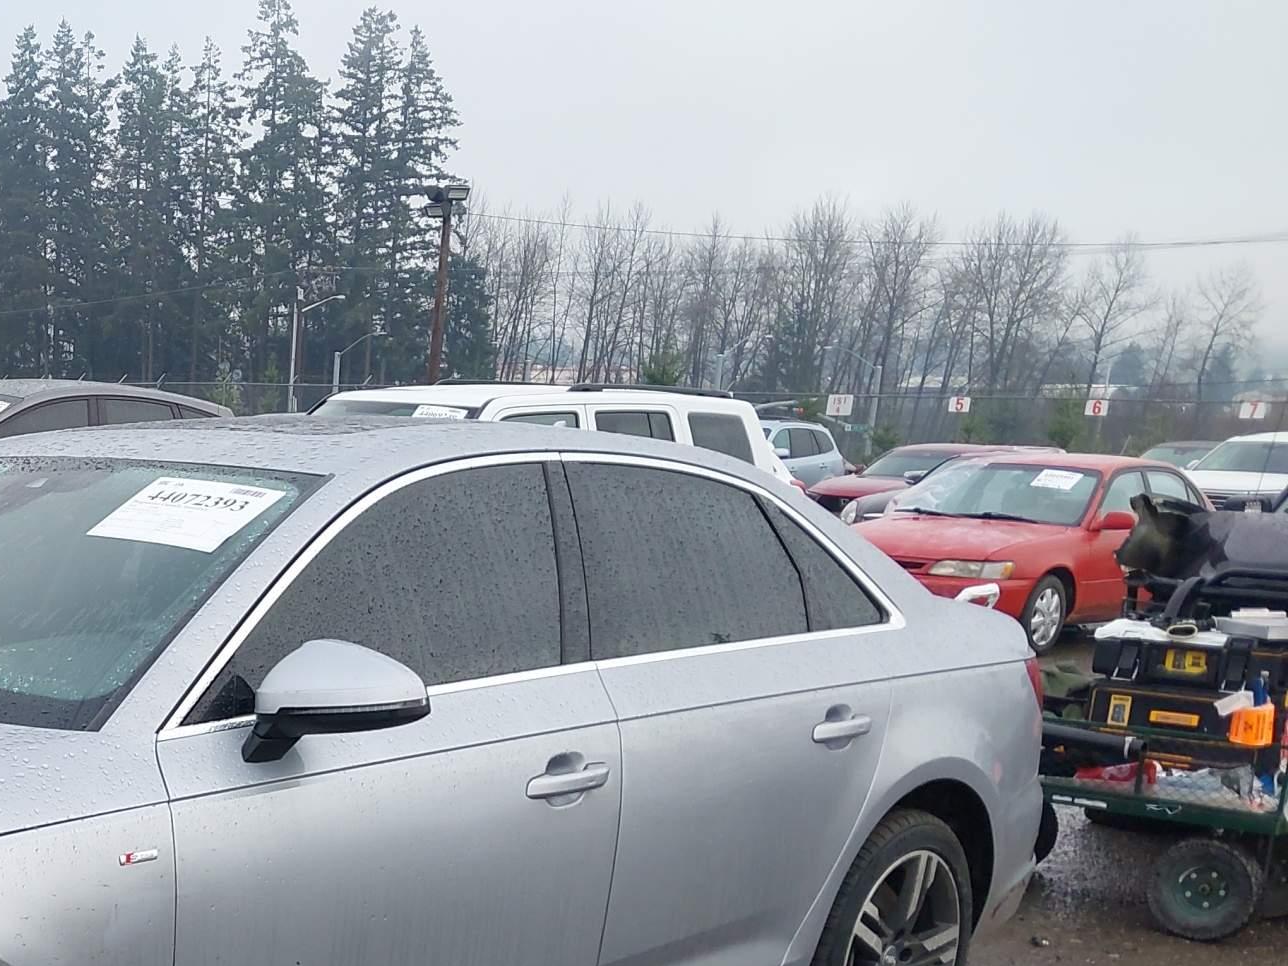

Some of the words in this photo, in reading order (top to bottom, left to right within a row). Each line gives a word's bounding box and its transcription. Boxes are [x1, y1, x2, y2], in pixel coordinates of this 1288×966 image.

[954, 399, 964, 412] 5
[1092, 400, 1102, 415] 6
[1249, 400, 1261, 417] 7
[147, 490, 250, 512] 44072393
